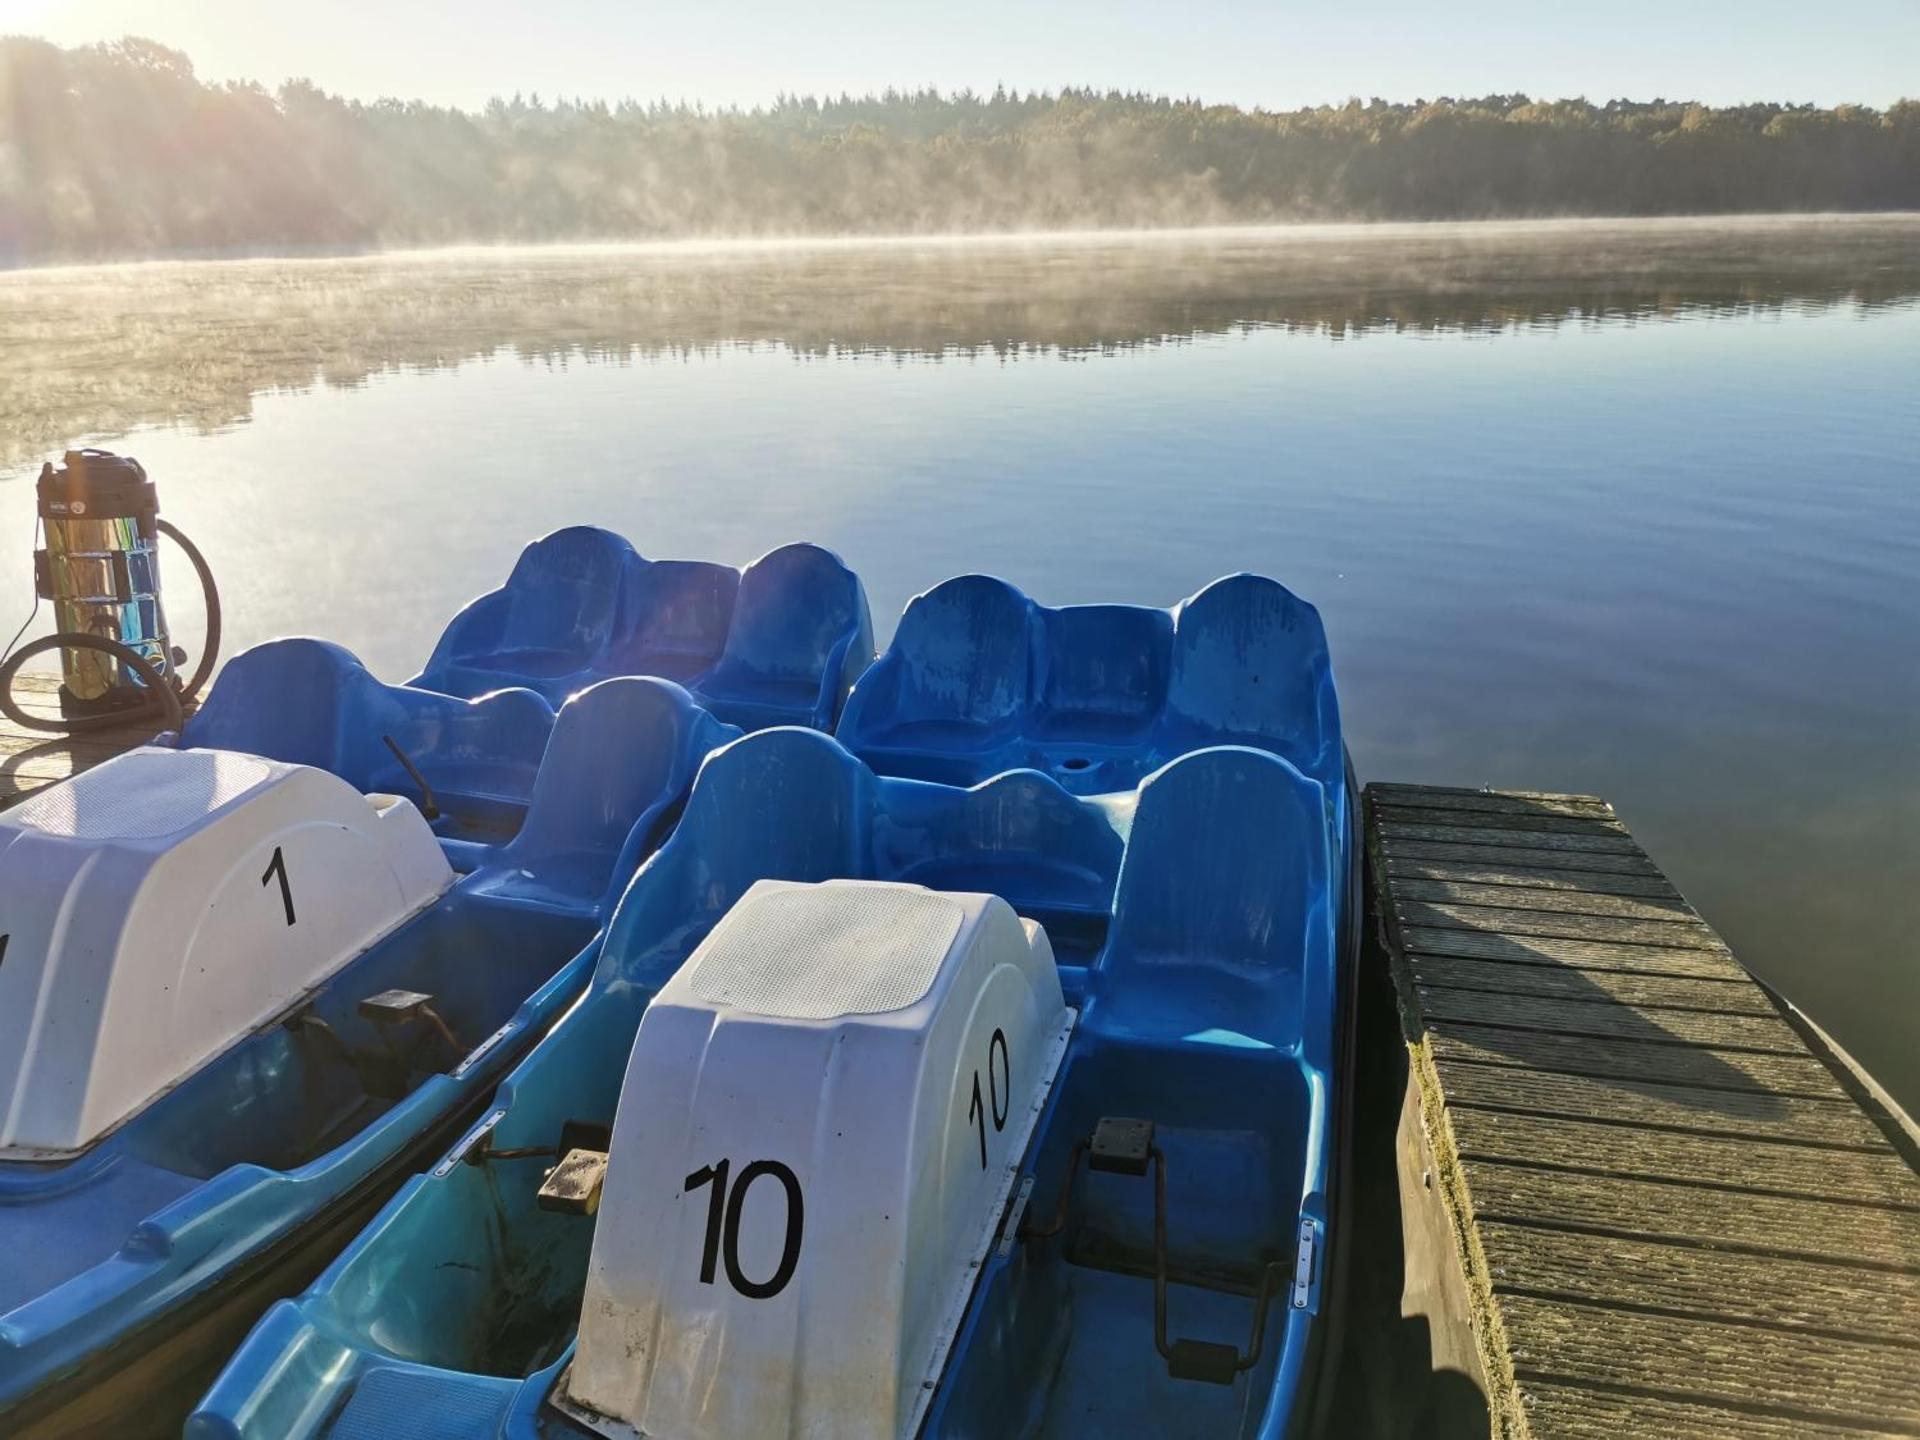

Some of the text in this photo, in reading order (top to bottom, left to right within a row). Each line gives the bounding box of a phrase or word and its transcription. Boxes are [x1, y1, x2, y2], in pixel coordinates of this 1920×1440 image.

[261, 845, 297, 927] 1
[968, 1027, 1010, 1172] 10
[683, 1157, 805, 1300] 10
